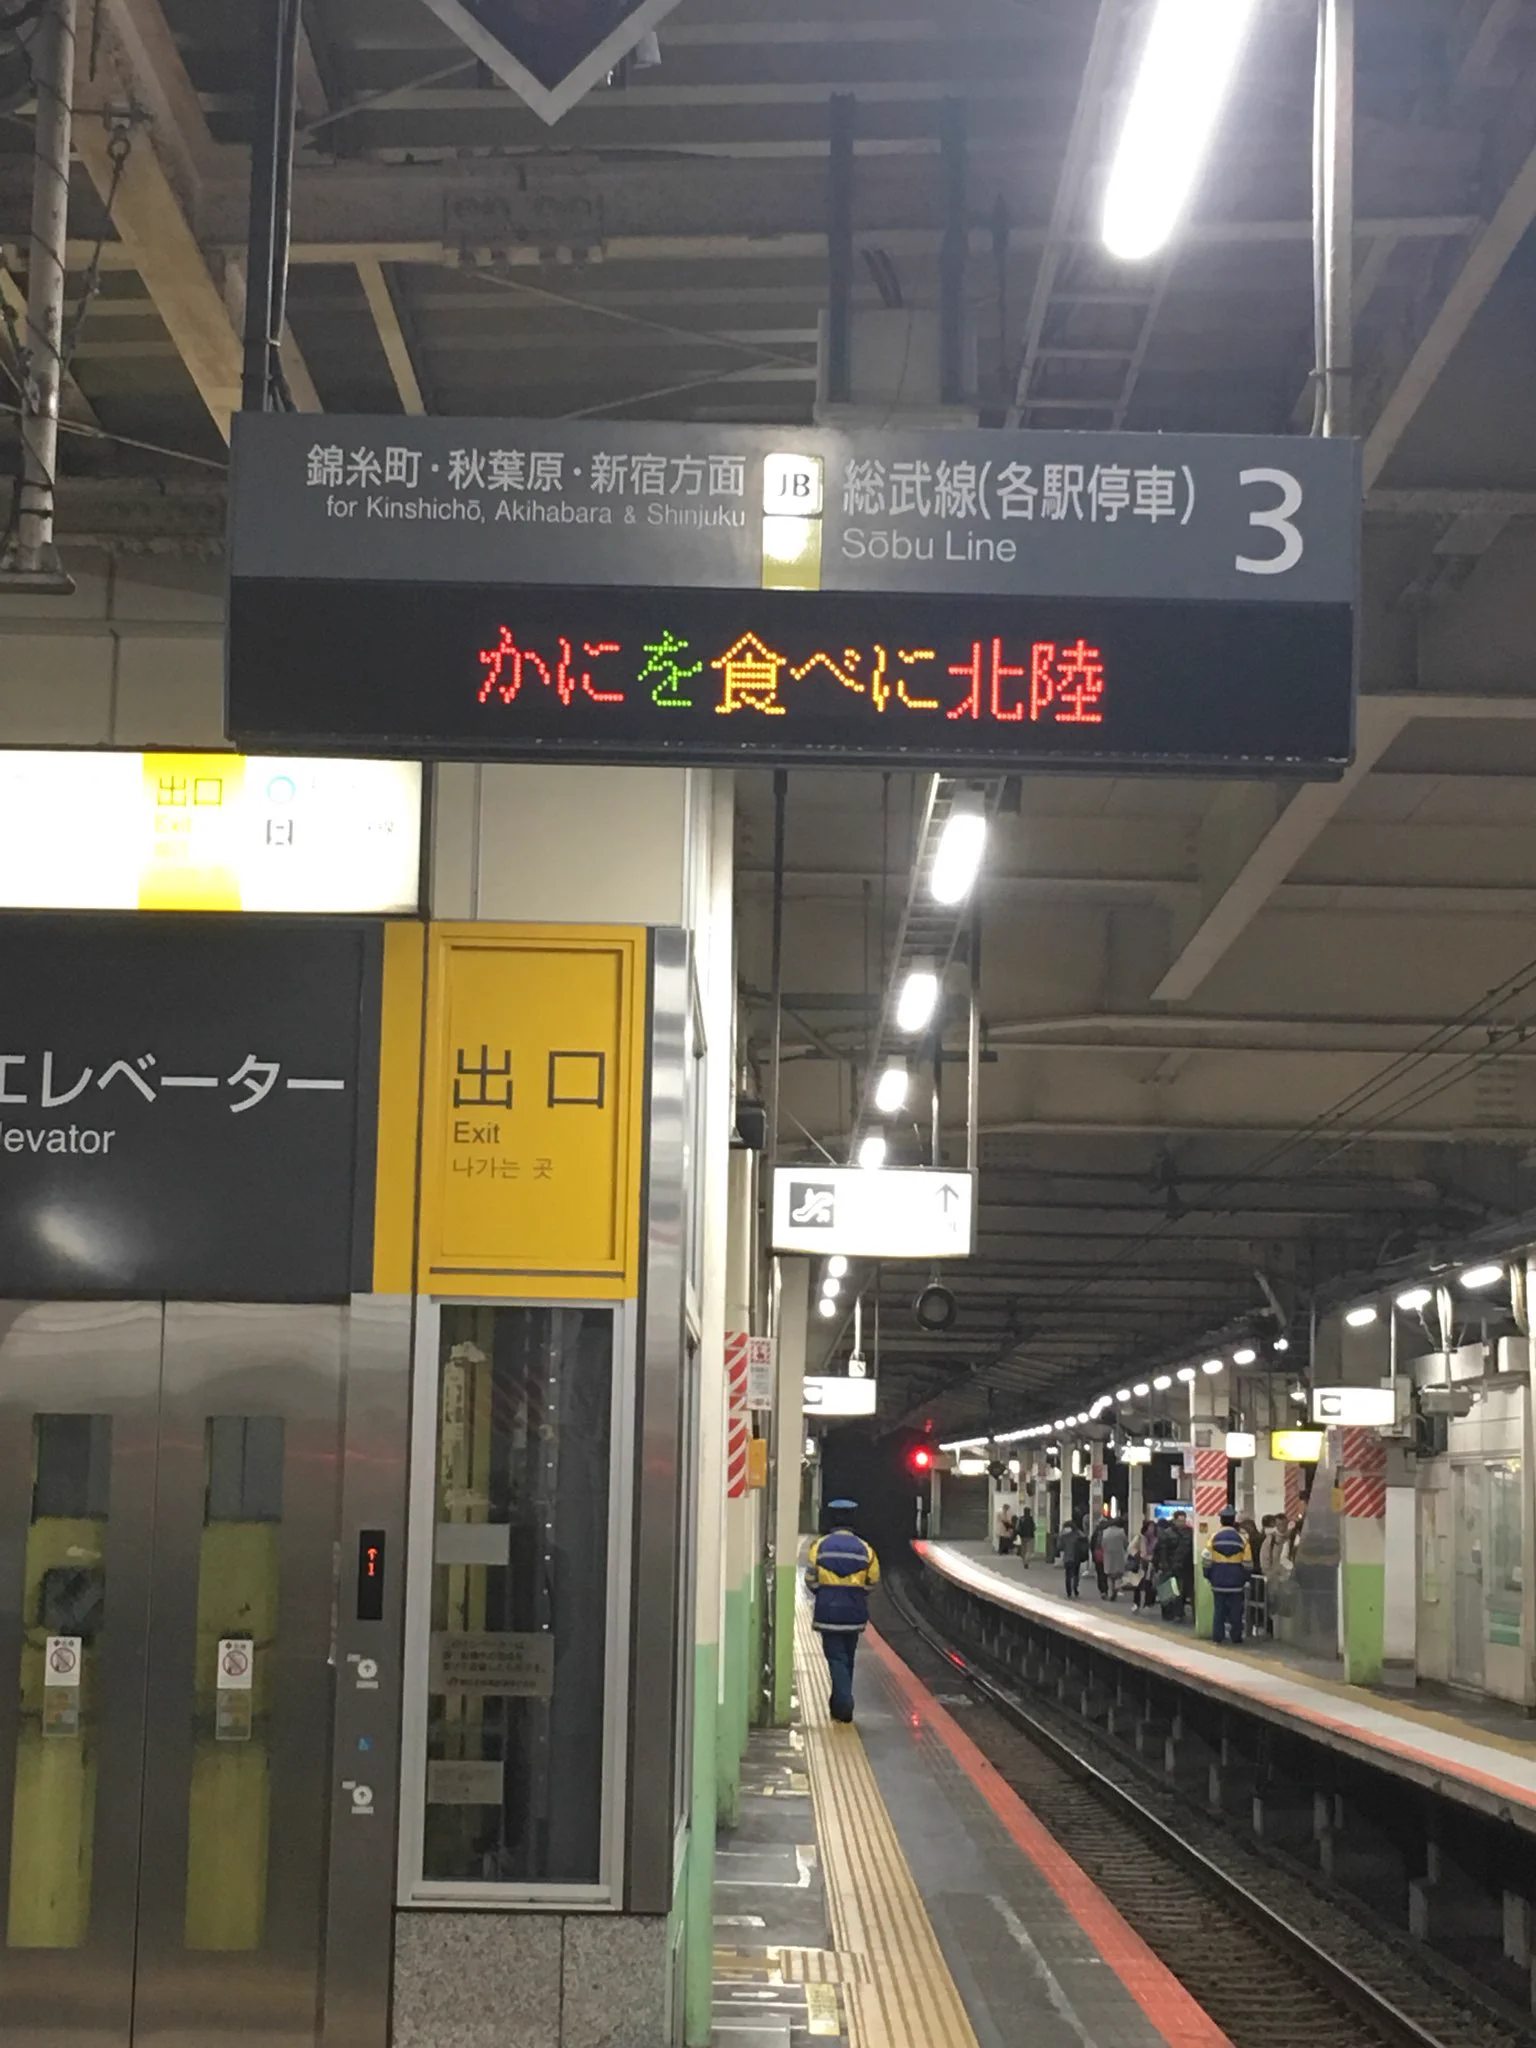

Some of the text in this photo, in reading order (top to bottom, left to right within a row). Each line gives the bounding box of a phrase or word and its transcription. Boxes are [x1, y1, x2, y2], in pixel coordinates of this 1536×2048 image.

[306, 444, 746, 496] 錦糸町・秋葉原・新宿方面
[777, 473, 811, 498] JB
[327, 495, 746, 531] for Kinshichō, Akihabara & Shinjuku
[842, 459, 1196, 526] 総武線(各駅停車)
[1235, 467, 1304, 575] 3
[842, 529, 1017, 563] Sōbu Line
[478, 625, 1104, 724] かにを食べに北陸
[157, 776, 223, 806] 出口
[0, 1050, 346, 1113] エレベーター
[453, 1044, 606, 1110] 出口
[454, 1121, 500, 1144] Exit
[452, 1156, 554, 1180] 나가는 곳
